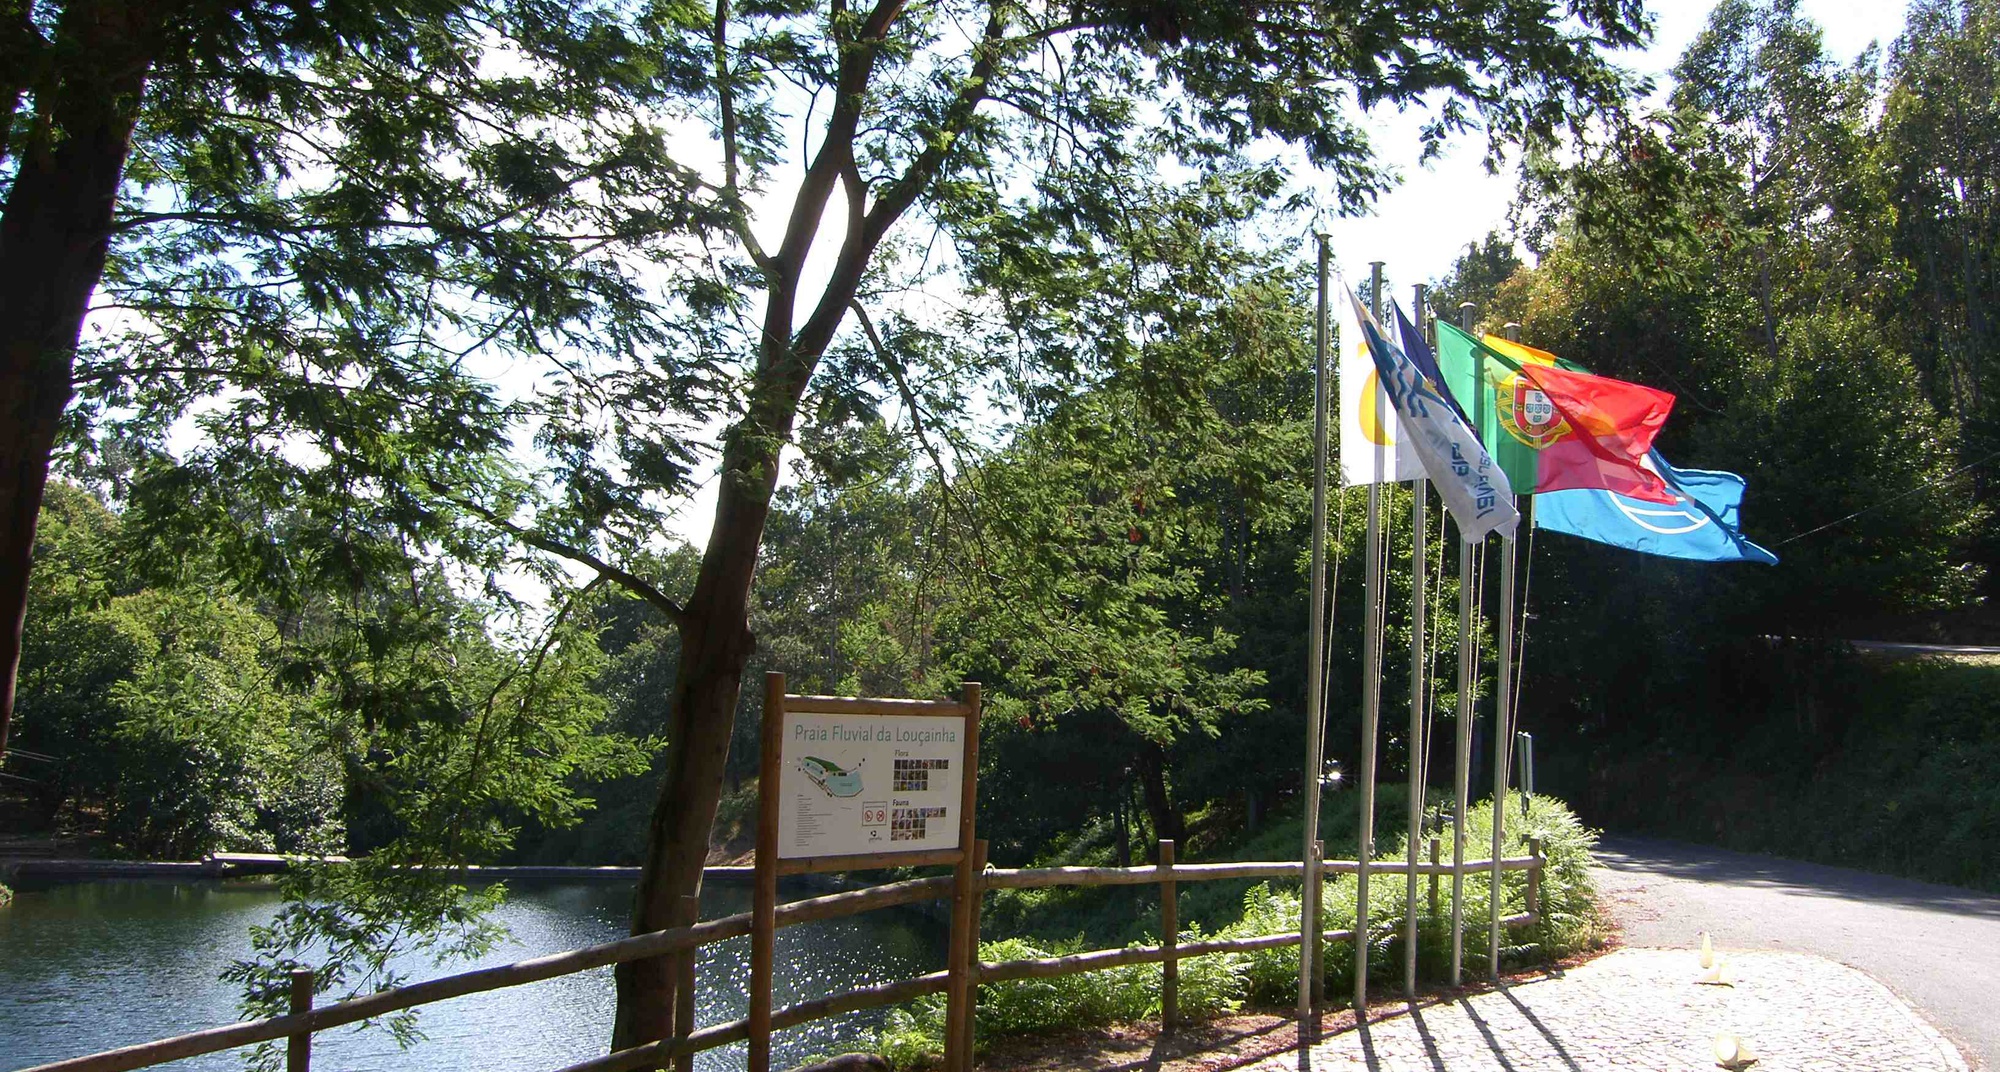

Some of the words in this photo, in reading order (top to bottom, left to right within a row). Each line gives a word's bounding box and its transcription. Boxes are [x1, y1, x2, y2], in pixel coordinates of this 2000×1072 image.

[795, 724, 827, 741] Praia
[832, 725, 873, 742] Fluvial
[877, 726, 891, 742] da
[896, 727, 956, 747] Louçainha
[894, 749, 909, 757] Flora
[892, 799, 909, 807] Fauna
